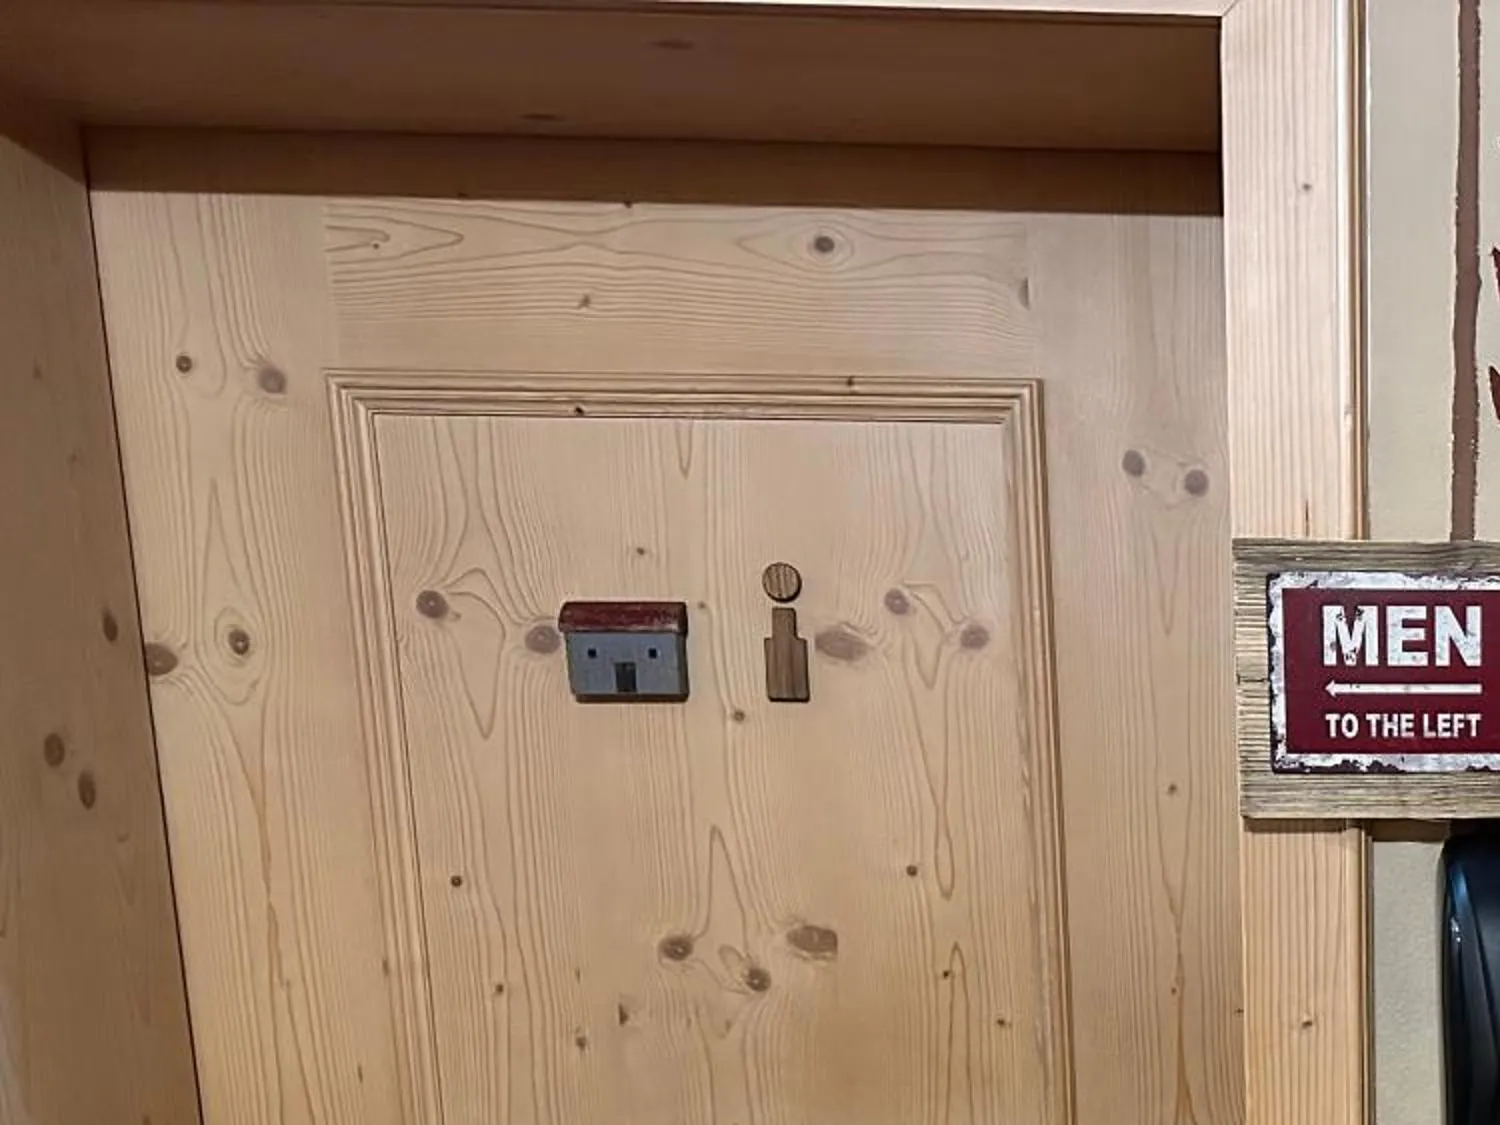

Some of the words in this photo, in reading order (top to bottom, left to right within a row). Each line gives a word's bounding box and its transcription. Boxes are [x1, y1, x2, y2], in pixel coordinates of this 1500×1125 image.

[1323, 605, 1481, 666] MEN
[1325, 713, 1358, 738] TO
[1366, 714, 1414, 737] THE
[1423, 714, 1481, 738] LEFT
